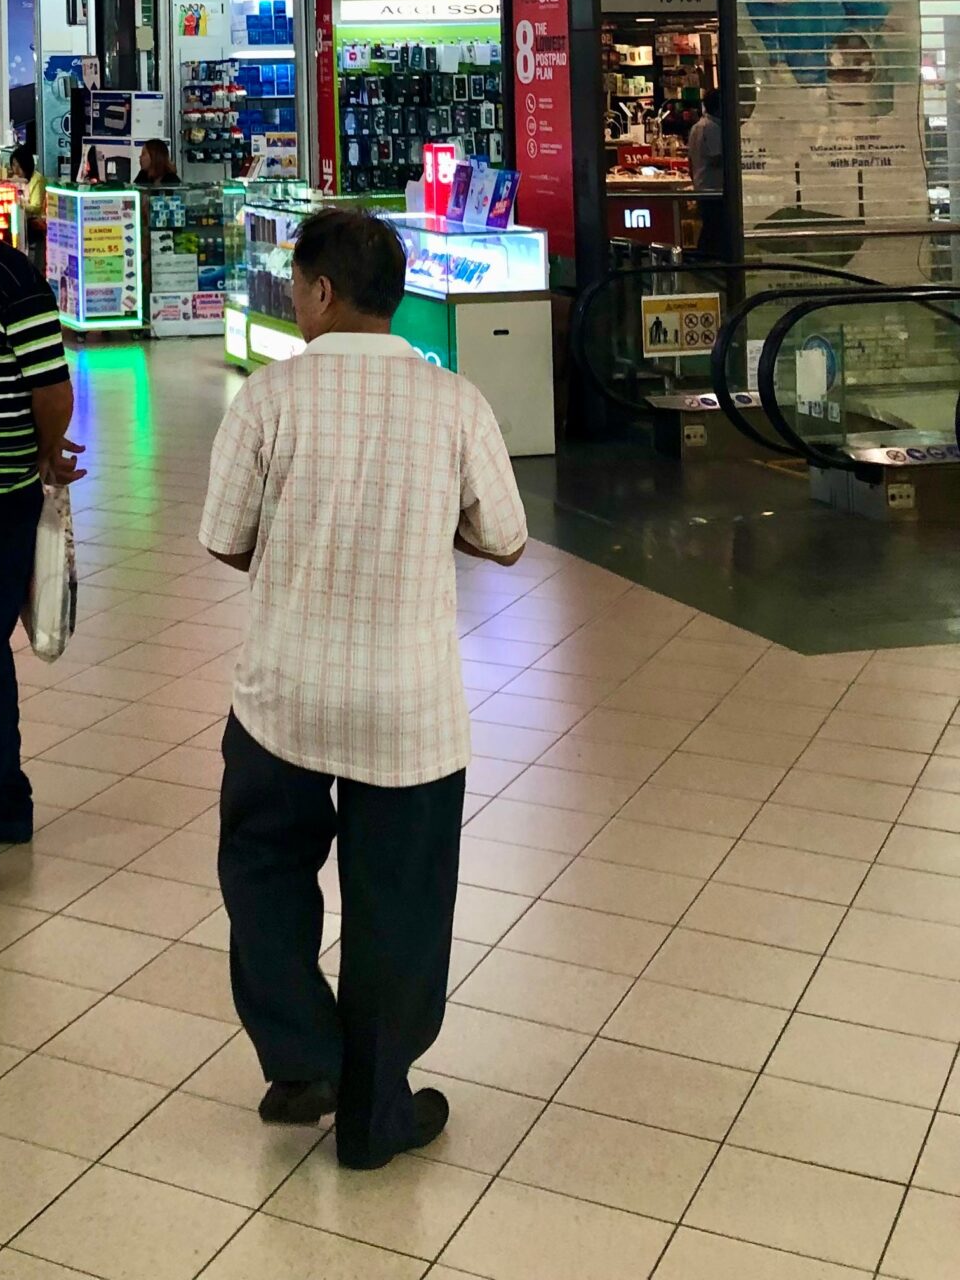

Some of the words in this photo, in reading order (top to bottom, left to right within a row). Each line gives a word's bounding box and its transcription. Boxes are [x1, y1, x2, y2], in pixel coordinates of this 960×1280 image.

[534, 22, 548, 36] THE
[515, 20, 535, 84] 8
[535, 52, 567, 66] POSTPAID
[536, 67, 553, 80] PLAN
[740, 161, 767, 170] outer
[323, 158, 333, 196] NE
[107, 244, 120, 253] $5
